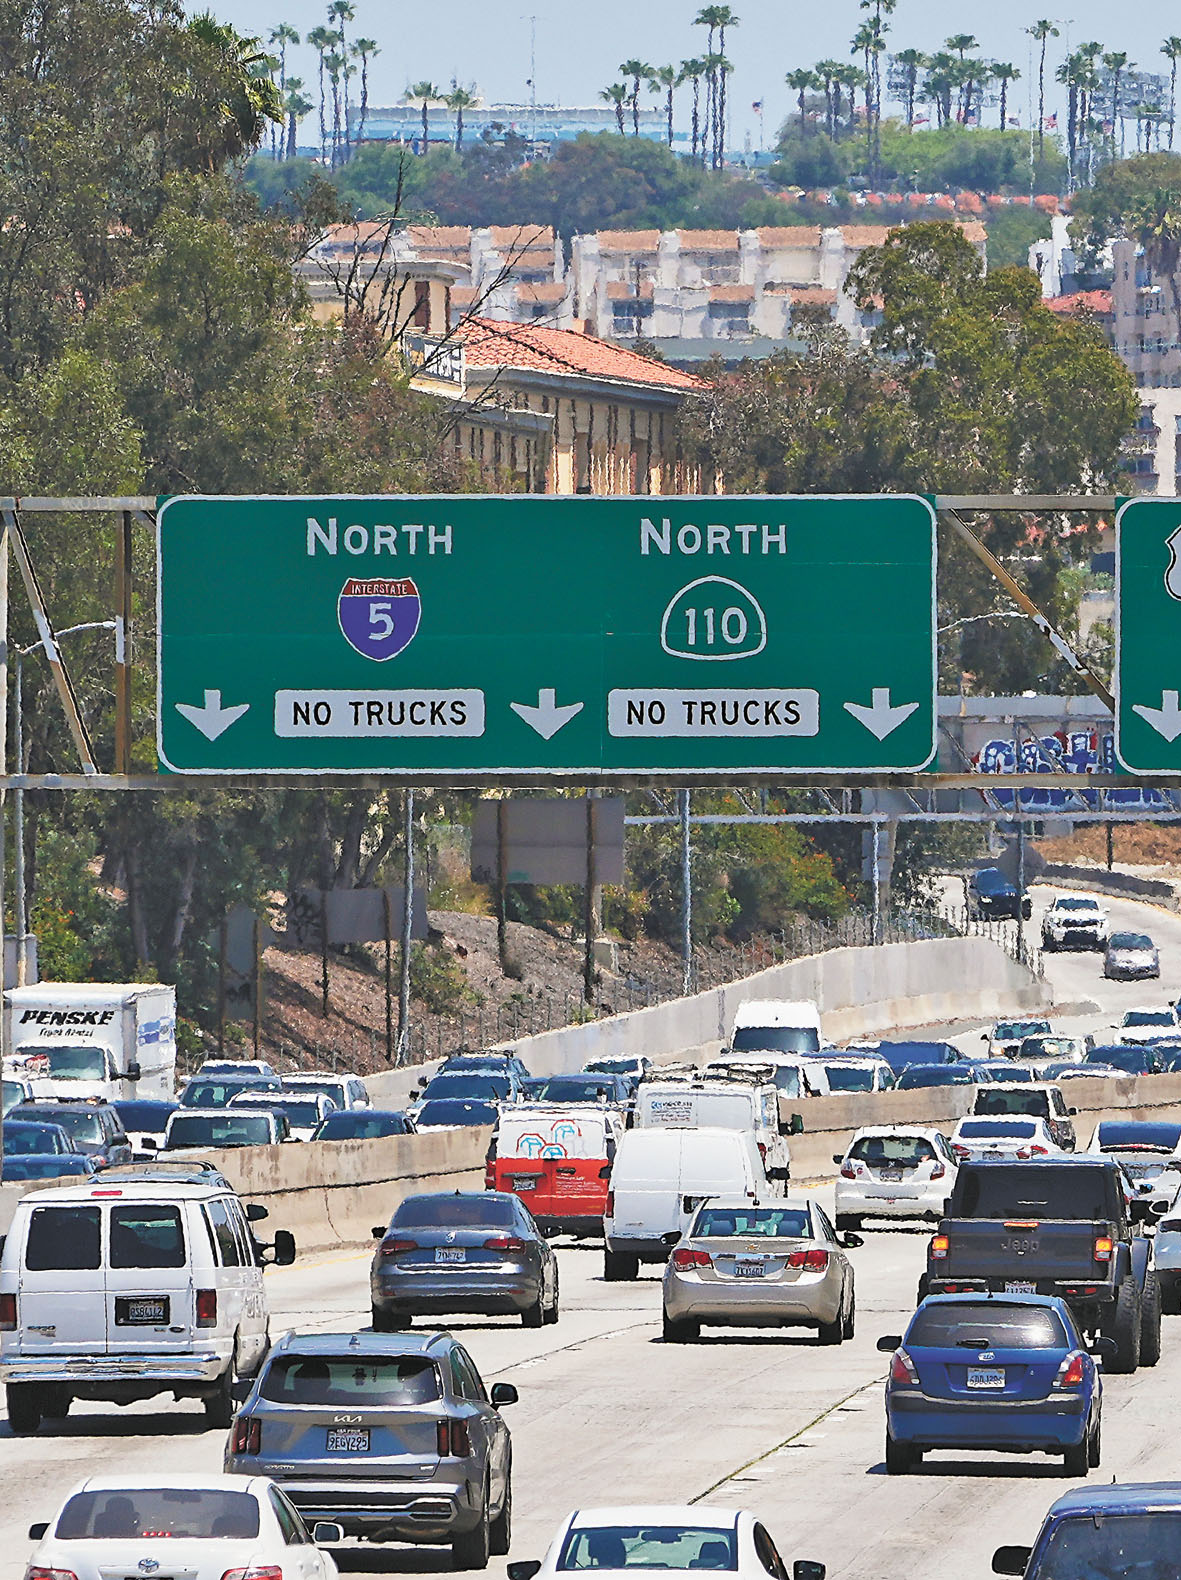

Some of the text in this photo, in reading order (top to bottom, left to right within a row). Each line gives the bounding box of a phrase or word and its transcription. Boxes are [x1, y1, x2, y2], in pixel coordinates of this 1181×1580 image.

[306, 518, 453, 557] NORTH
[640, 518, 788, 557] NORTH
[351, 584, 409, 595] INTERSTATE
[368, 603, 394, 641] 5
[684, 607, 747, 645] 110
[292, 701, 468, 728] NO TRUCKS
[627, 701, 802, 728] NO TRUCKS
[19, 1010, 114, 1025] PENSKE
